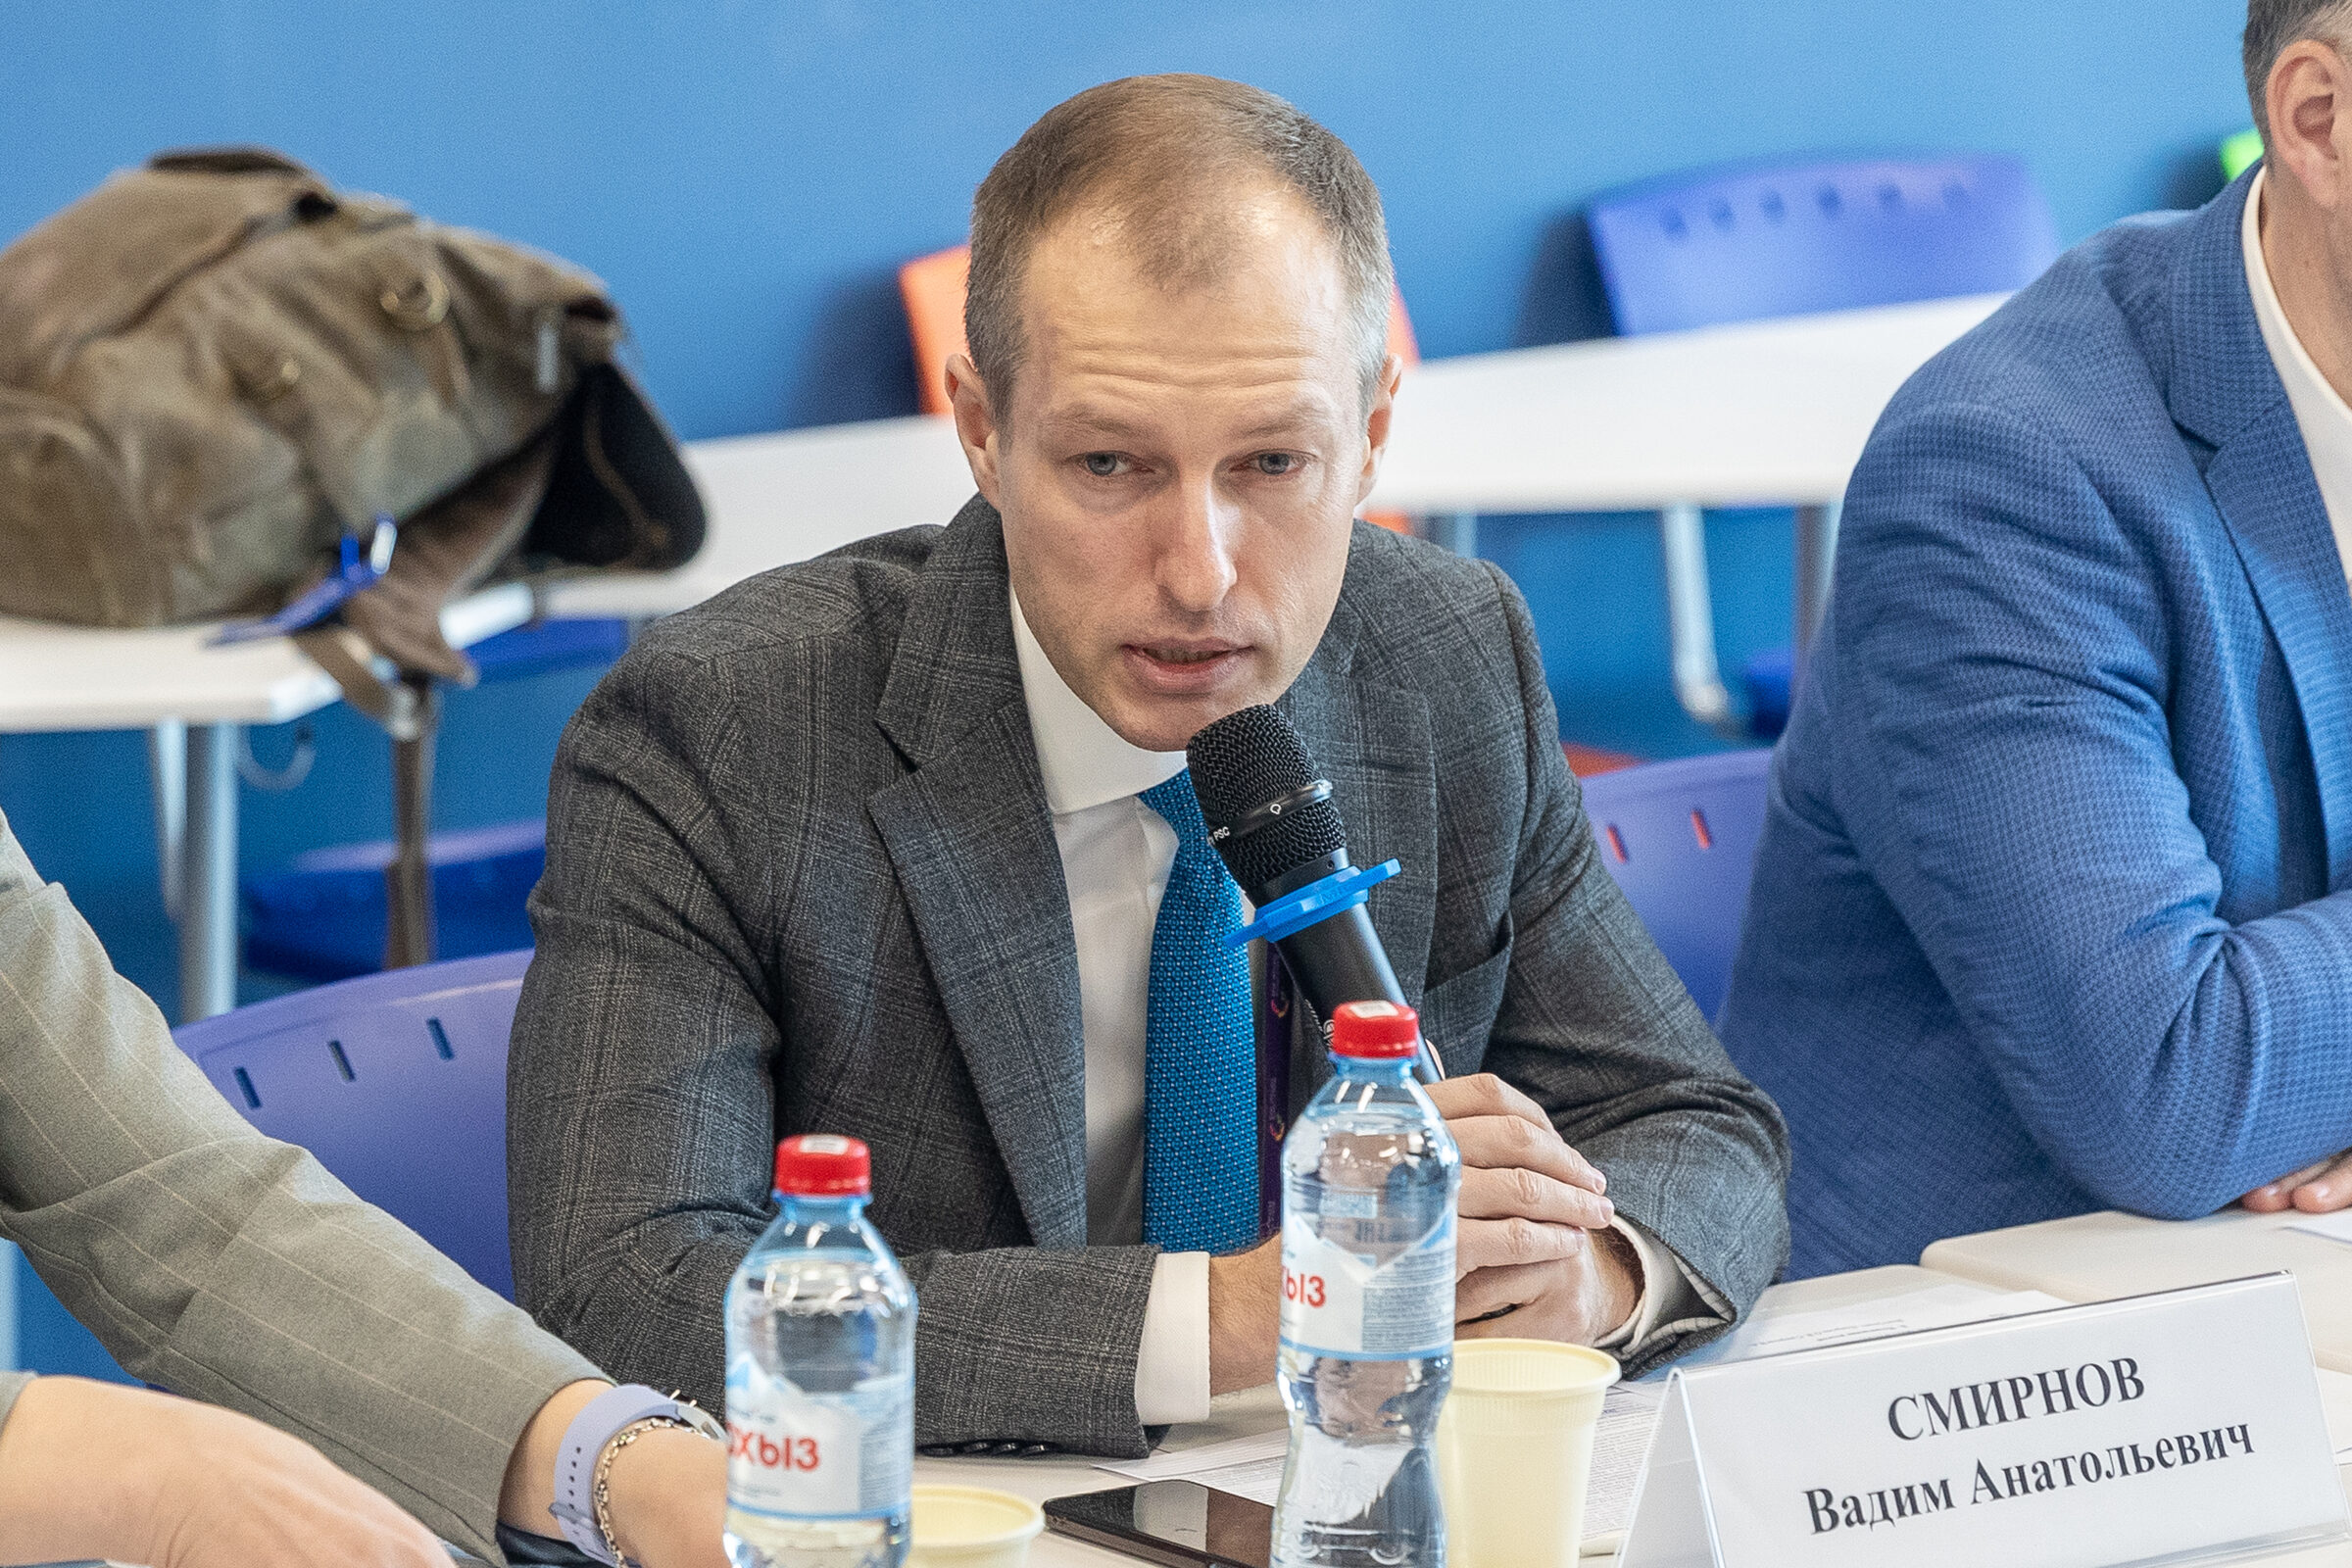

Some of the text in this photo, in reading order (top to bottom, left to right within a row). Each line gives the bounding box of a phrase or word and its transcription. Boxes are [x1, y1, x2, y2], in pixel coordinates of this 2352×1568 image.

[1282, 1265, 1326, 1307] ЫЗ
[1887, 1356, 2146, 1441] СМИРНОВ
[1802, 1423, 2256, 1535] Вадим Анатольевич
